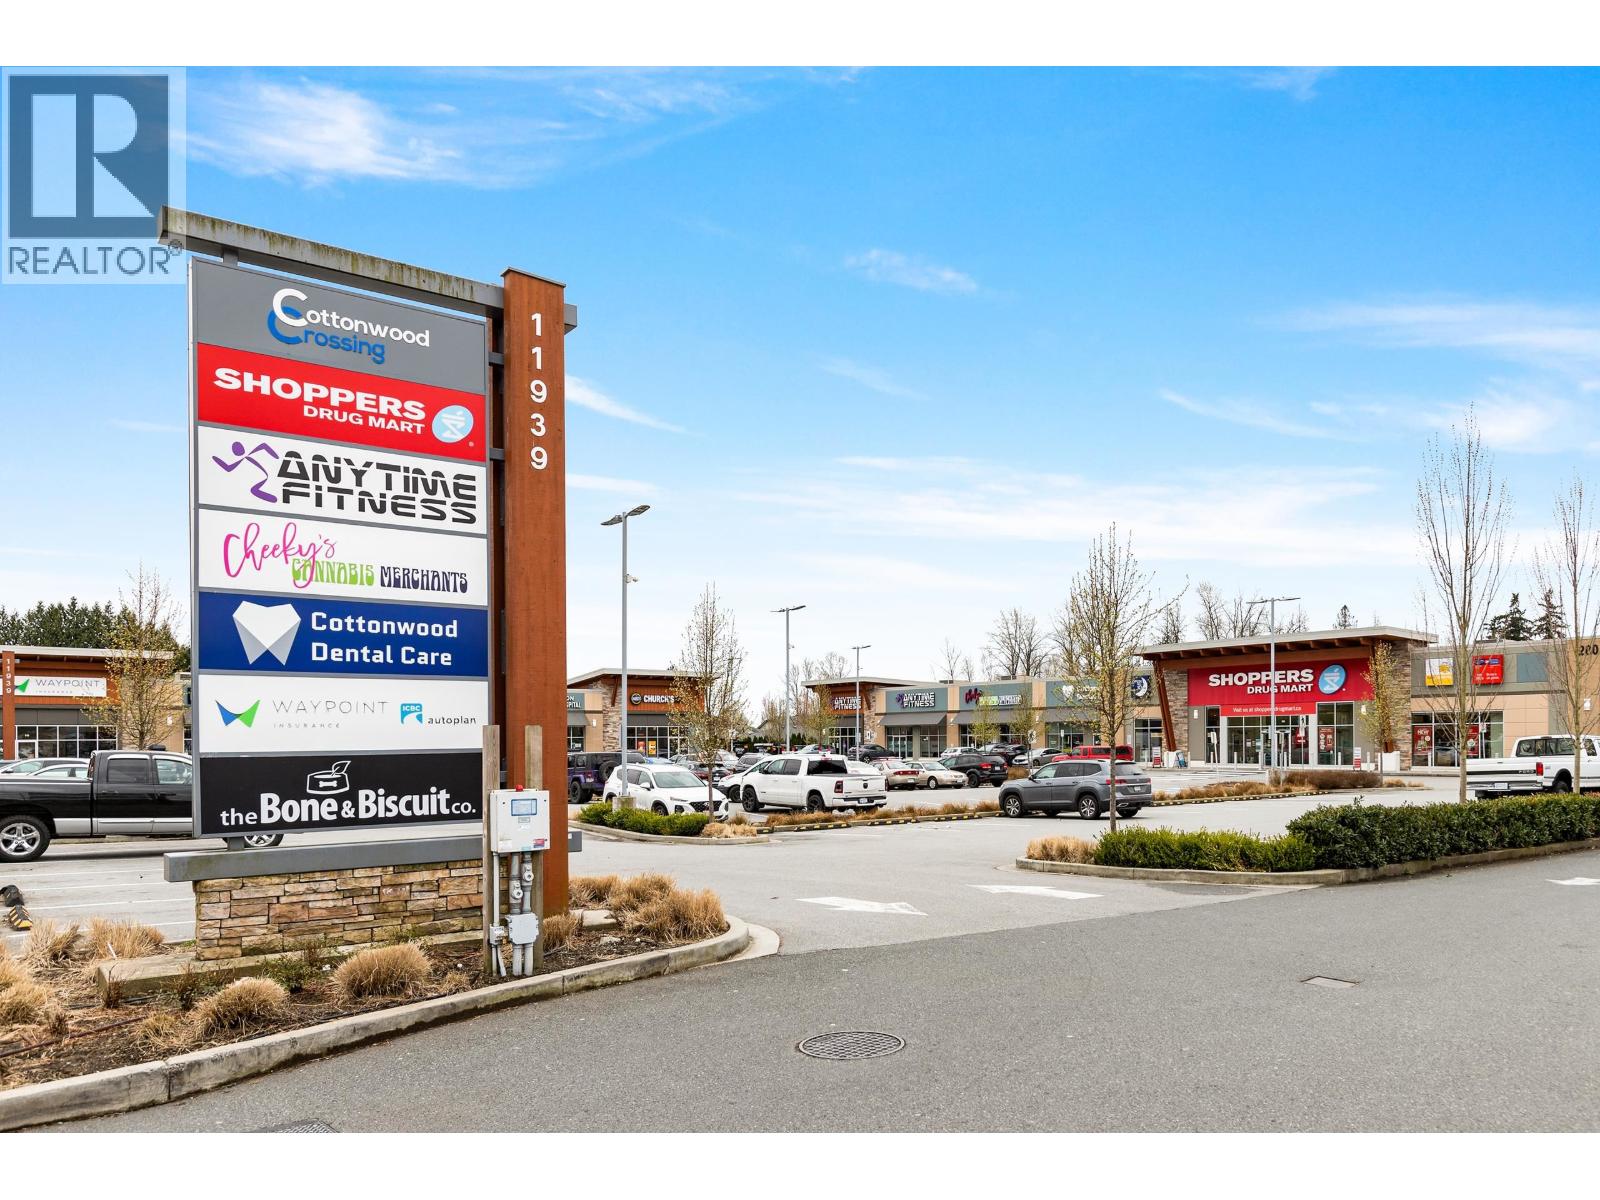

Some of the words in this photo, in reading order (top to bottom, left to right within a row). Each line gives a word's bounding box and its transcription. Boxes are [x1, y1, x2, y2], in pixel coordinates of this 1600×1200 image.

[272, 288, 431, 347] Cottonwood
[266, 306, 386, 364] Crossing
[213, 367, 426, 421] SHOPPERS
[530, 313, 548, 471] 11939
[303, 404, 363, 426] DRUG
[368, 416, 426, 435] MART
[277, 451, 477, 502] ANYTIME
[282, 481, 477, 525] FITNESS
[223, 522, 338, 589] Cheeky's
[291, 558, 375, 587] CANNABIS
[380, 565, 468, 594] MERCHANTS
[310, 611, 458, 639] Cottonwood
[311, 642, 394, 664] Dental
[400, 646, 452, 667] Care
[35, 679, 100, 688] WAYPOINT
[1208, 669, 1314, 687] SHOPPERS
[1247, 685, 1278, 695] DRUG
[1280, 683, 1314, 693] MART
[273, 699, 389, 716] WAYPOINT
[427, 714, 477, 726] autoplan
[903, 700, 935, 708] FITNESS
[220, 808, 258, 827] the
[259, 793, 339, 825] Bone
[341, 800, 356, 819] &
[359, 786, 451, 819] Biscuit
